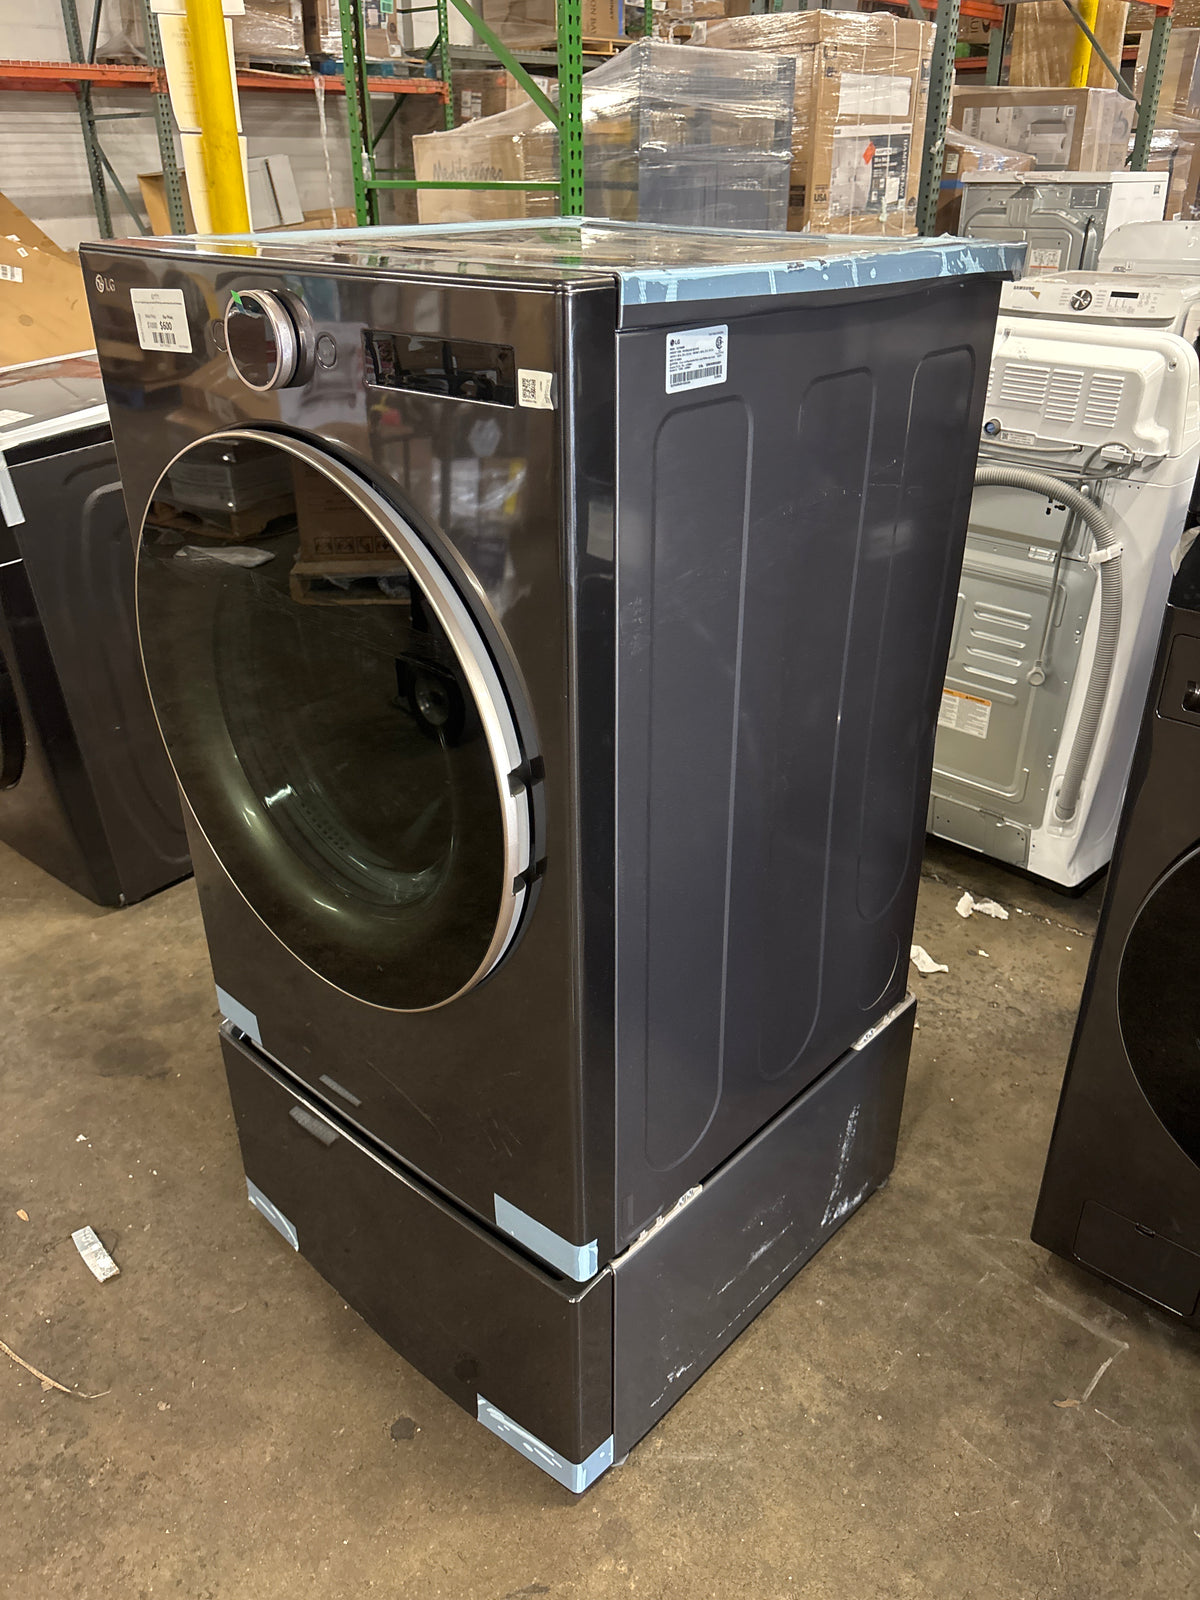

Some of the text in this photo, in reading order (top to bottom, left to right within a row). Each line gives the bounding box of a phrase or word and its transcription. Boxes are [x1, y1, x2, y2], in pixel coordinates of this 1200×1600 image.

[901, 138, 909, 181] HAMPTON
[814, 193, 827, 202] USA
[104, 277, 116, 292] LG
